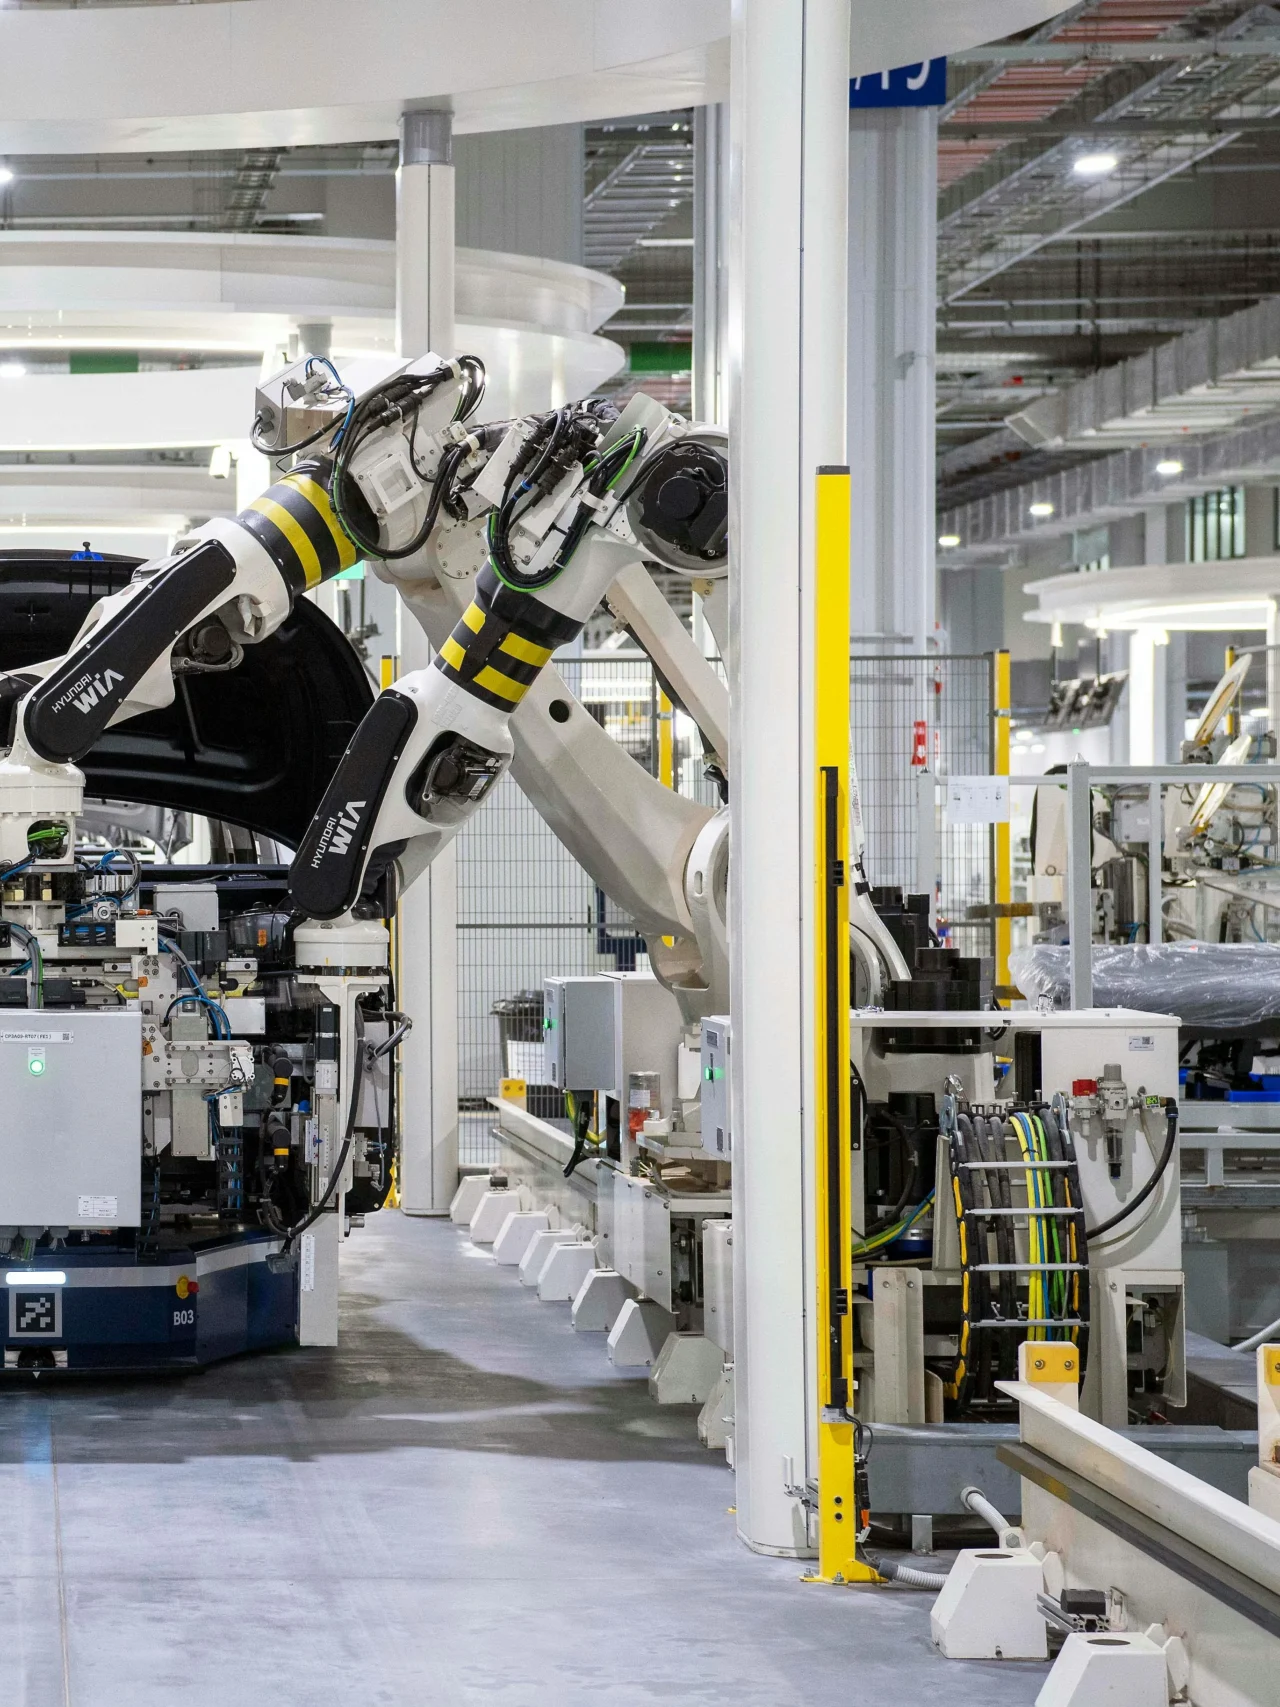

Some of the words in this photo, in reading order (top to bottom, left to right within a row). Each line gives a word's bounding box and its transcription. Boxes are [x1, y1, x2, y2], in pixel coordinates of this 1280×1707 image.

[51, 673, 93, 714] HYUNDAI
[310, 817, 337, 869] HYUNDAI
[173, 1309, 195, 1326] B03
